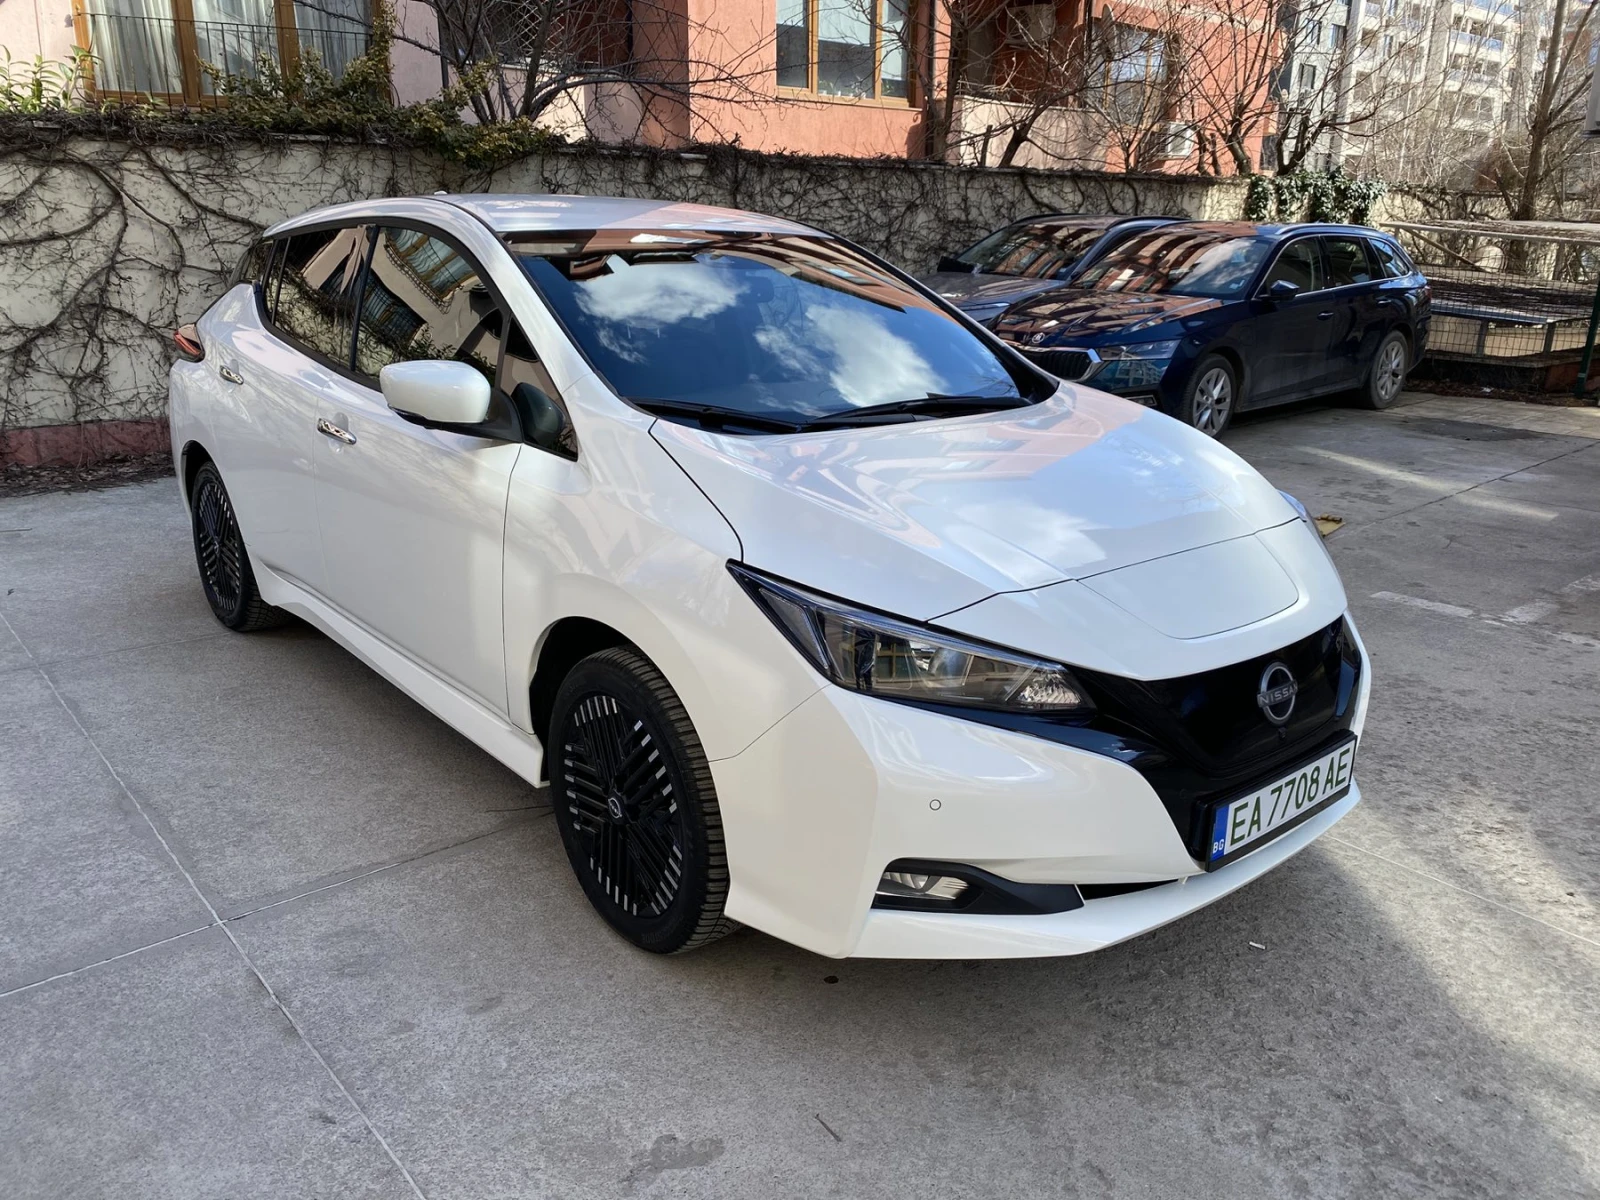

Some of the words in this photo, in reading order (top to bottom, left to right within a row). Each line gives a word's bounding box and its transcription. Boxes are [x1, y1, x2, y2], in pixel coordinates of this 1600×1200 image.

[1257, 682, 1298, 707] NISSAN
[1230, 796, 1261, 846] EA
[1267, 765, 1320, 827] 7708
[1322, 748, 1351, 795] AE
[1212, 838, 1225, 854] BG
